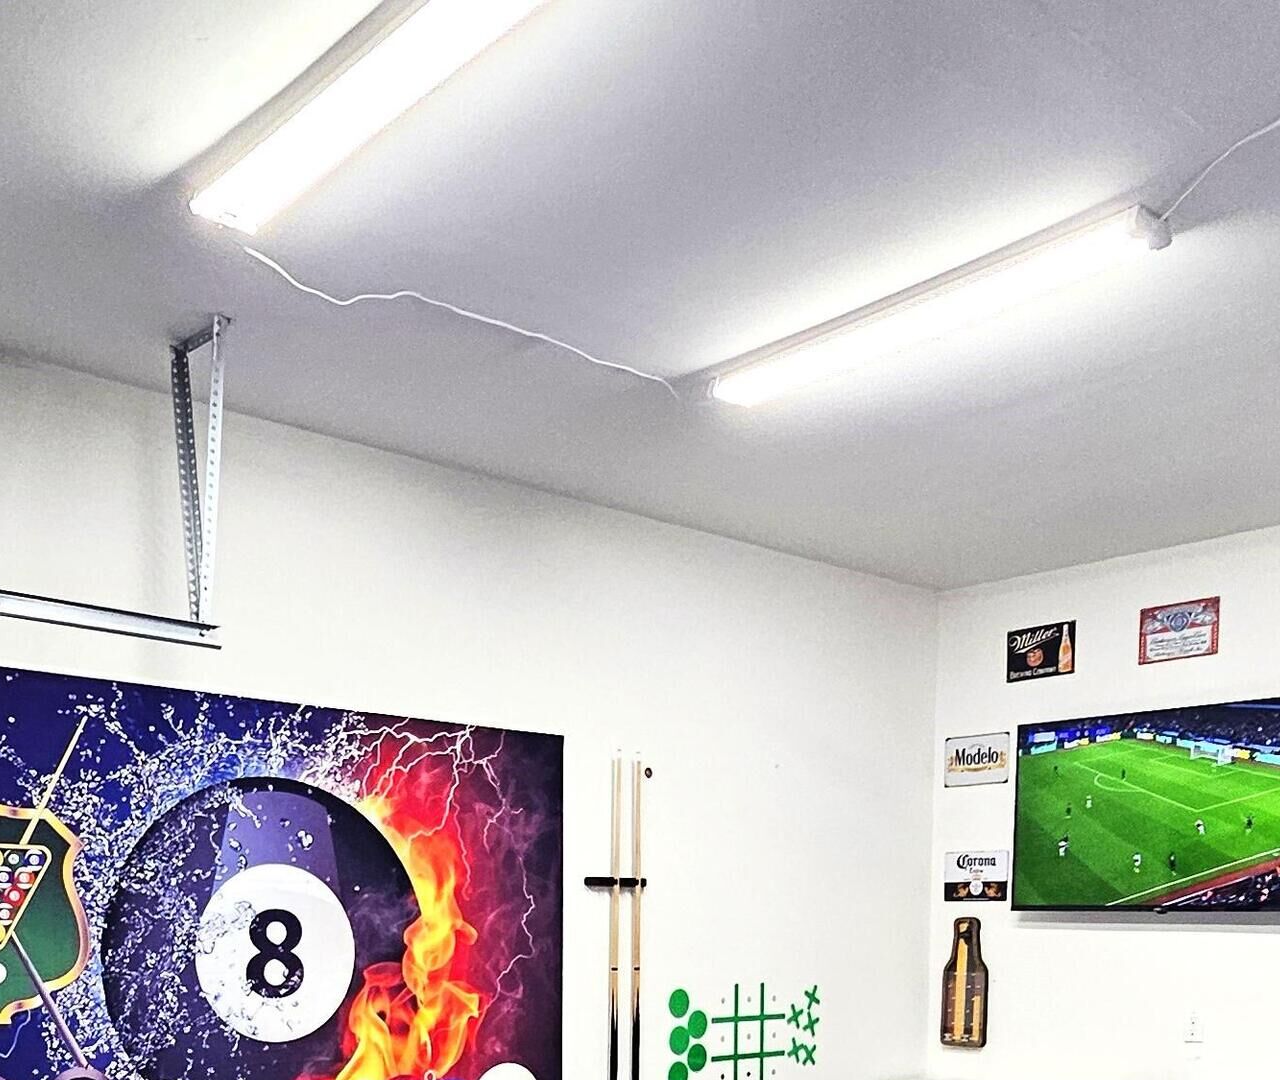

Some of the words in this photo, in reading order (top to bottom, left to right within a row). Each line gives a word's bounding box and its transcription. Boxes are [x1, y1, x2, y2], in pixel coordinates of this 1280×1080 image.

[1009, 626, 1058, 652] Miller
[955, 747, 999, 766] Modelo
[956, 854, 997, 870] Corona
[246, 908, 305, 999] 8
